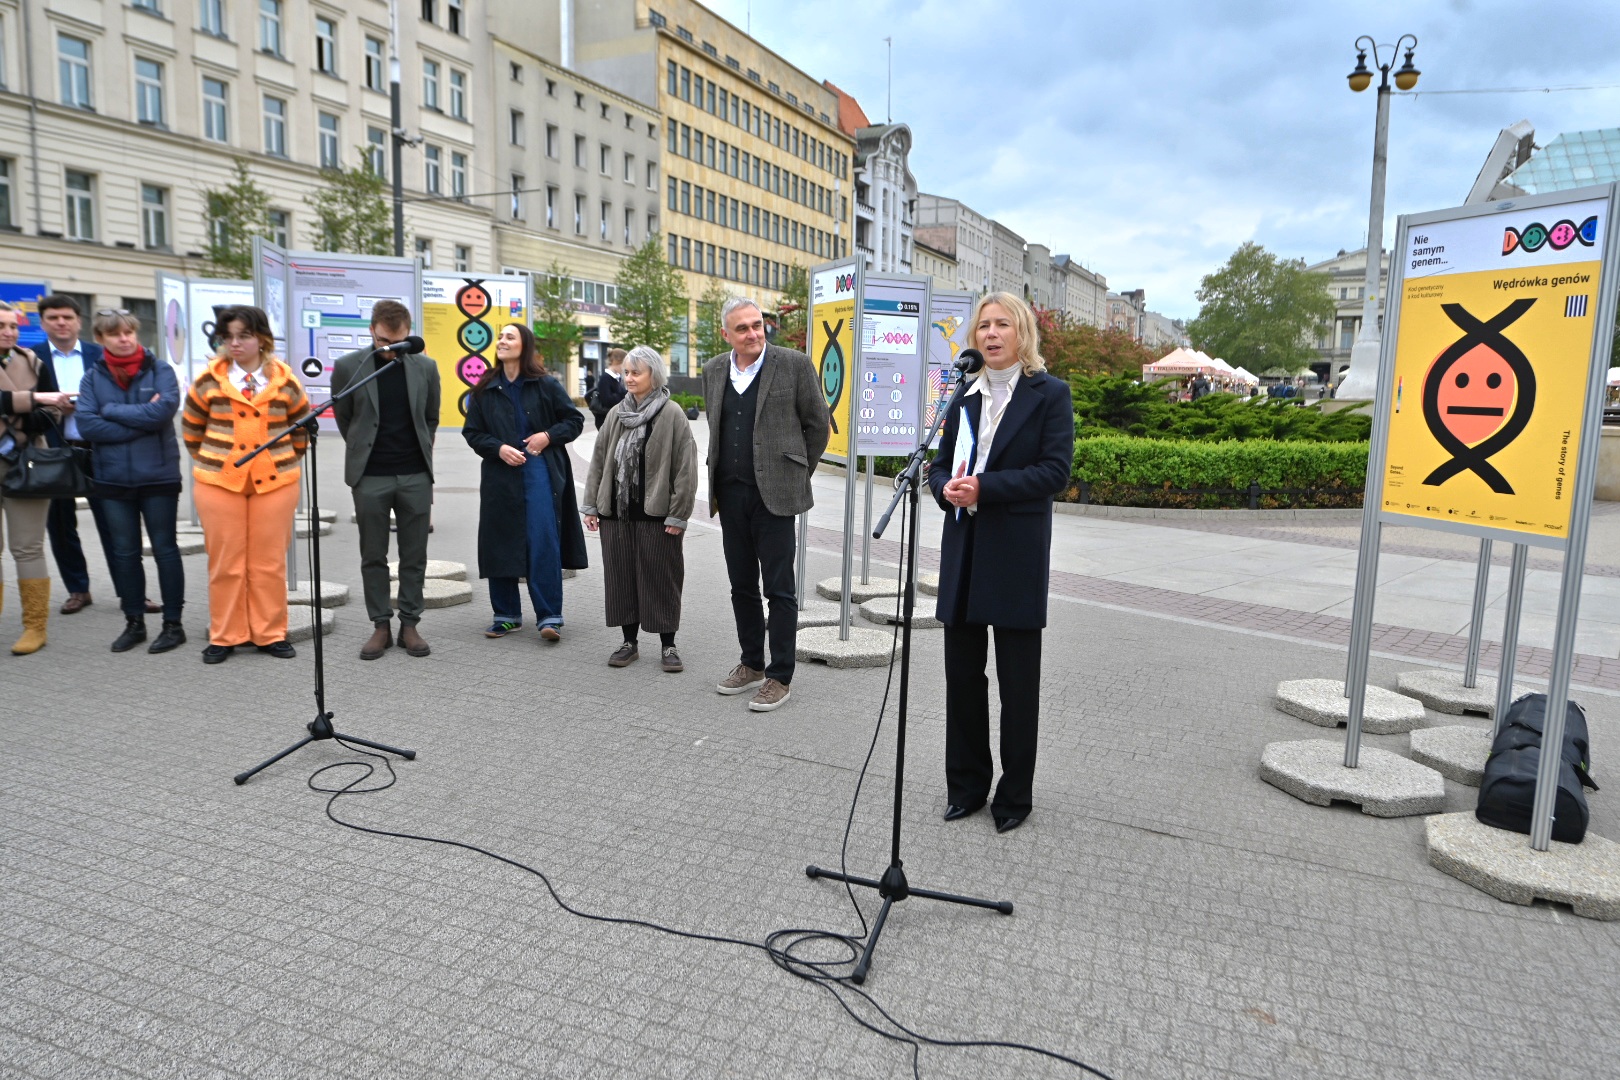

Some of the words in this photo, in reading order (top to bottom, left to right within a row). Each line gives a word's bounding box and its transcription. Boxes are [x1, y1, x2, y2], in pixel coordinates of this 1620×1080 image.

[1414, 236, 1429, 245] Nie
[1412, 246, 1445, 256] samym
[1411, 257, 1448, 270] genem...
[1493, 276, 1548, 291] Wędrówka
[1551, 273, 1590, 287] genów
[1561, 430, 1571, 445] The
[1558, 446, 1568, 466] story
[1558, 467, 1566, 476] of
[1555, 477, 1563, 500] genes
